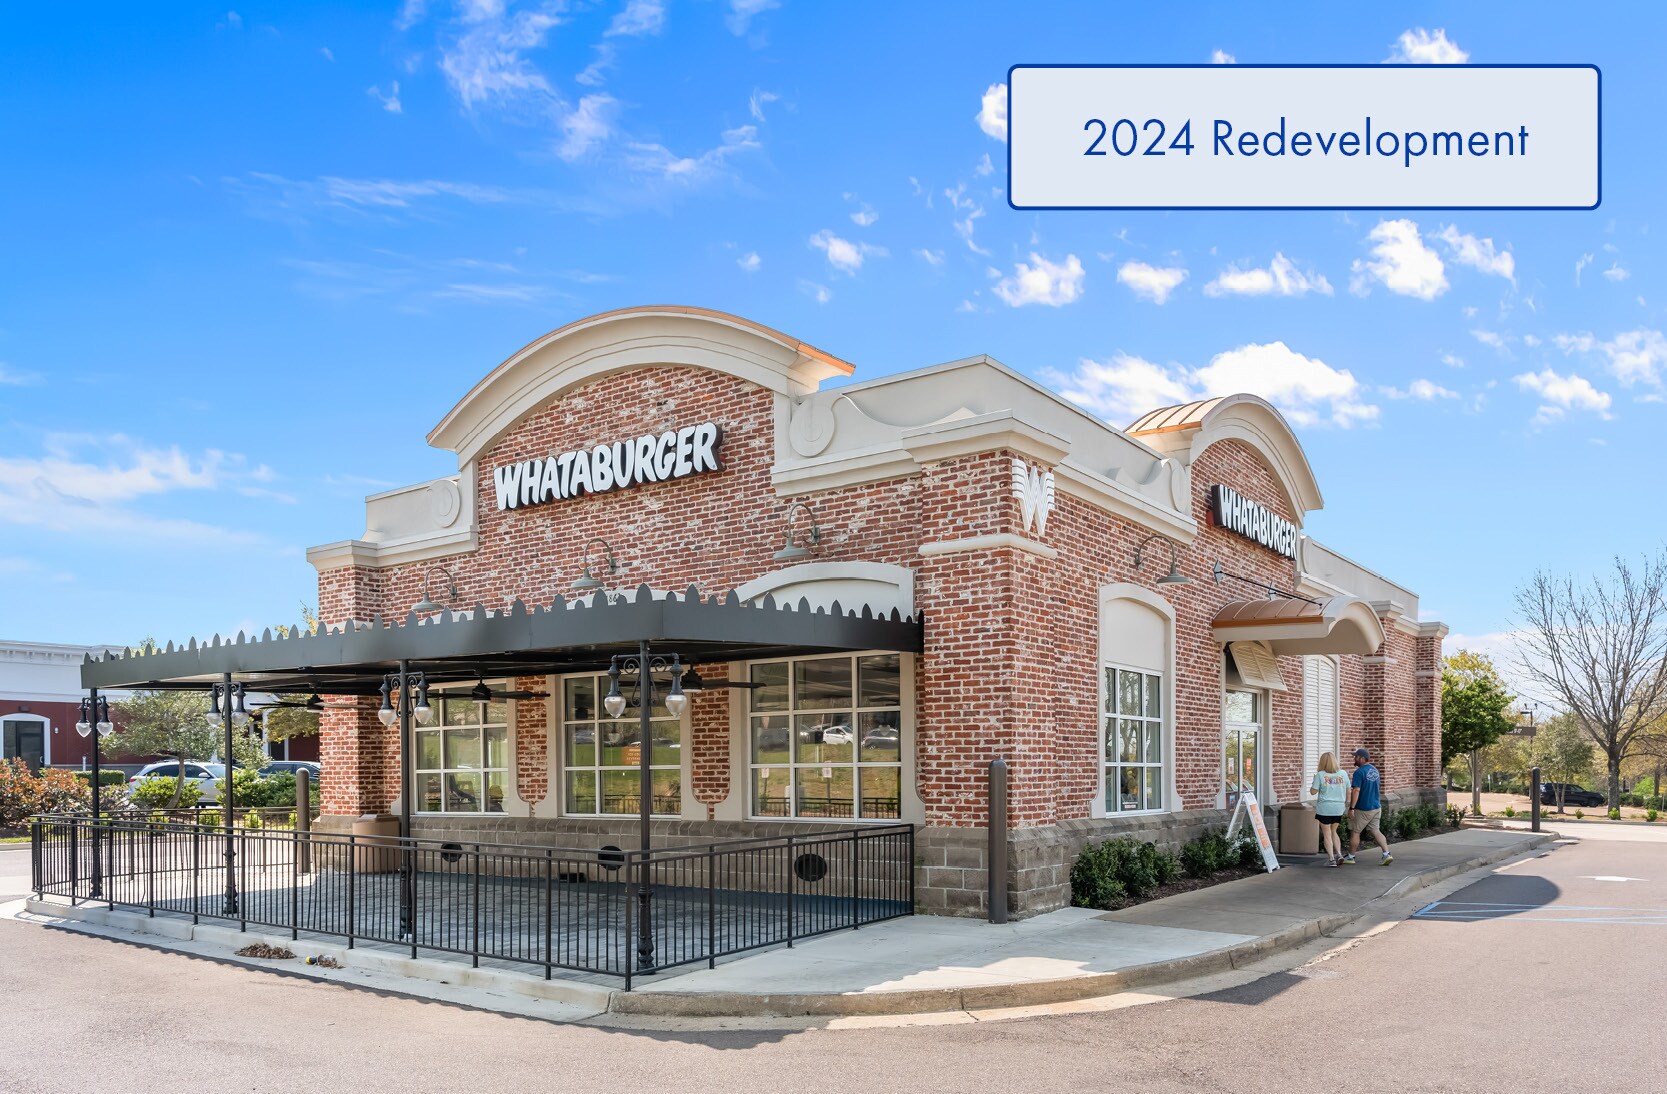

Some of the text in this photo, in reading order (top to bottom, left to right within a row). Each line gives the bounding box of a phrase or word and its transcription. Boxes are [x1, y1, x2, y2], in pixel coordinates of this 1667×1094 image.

[494, 422, 718, 511] WHATABURGER
[1012, 458, 1055, 536] W
[1219, 484, 1298, 560] WHATABURGER
